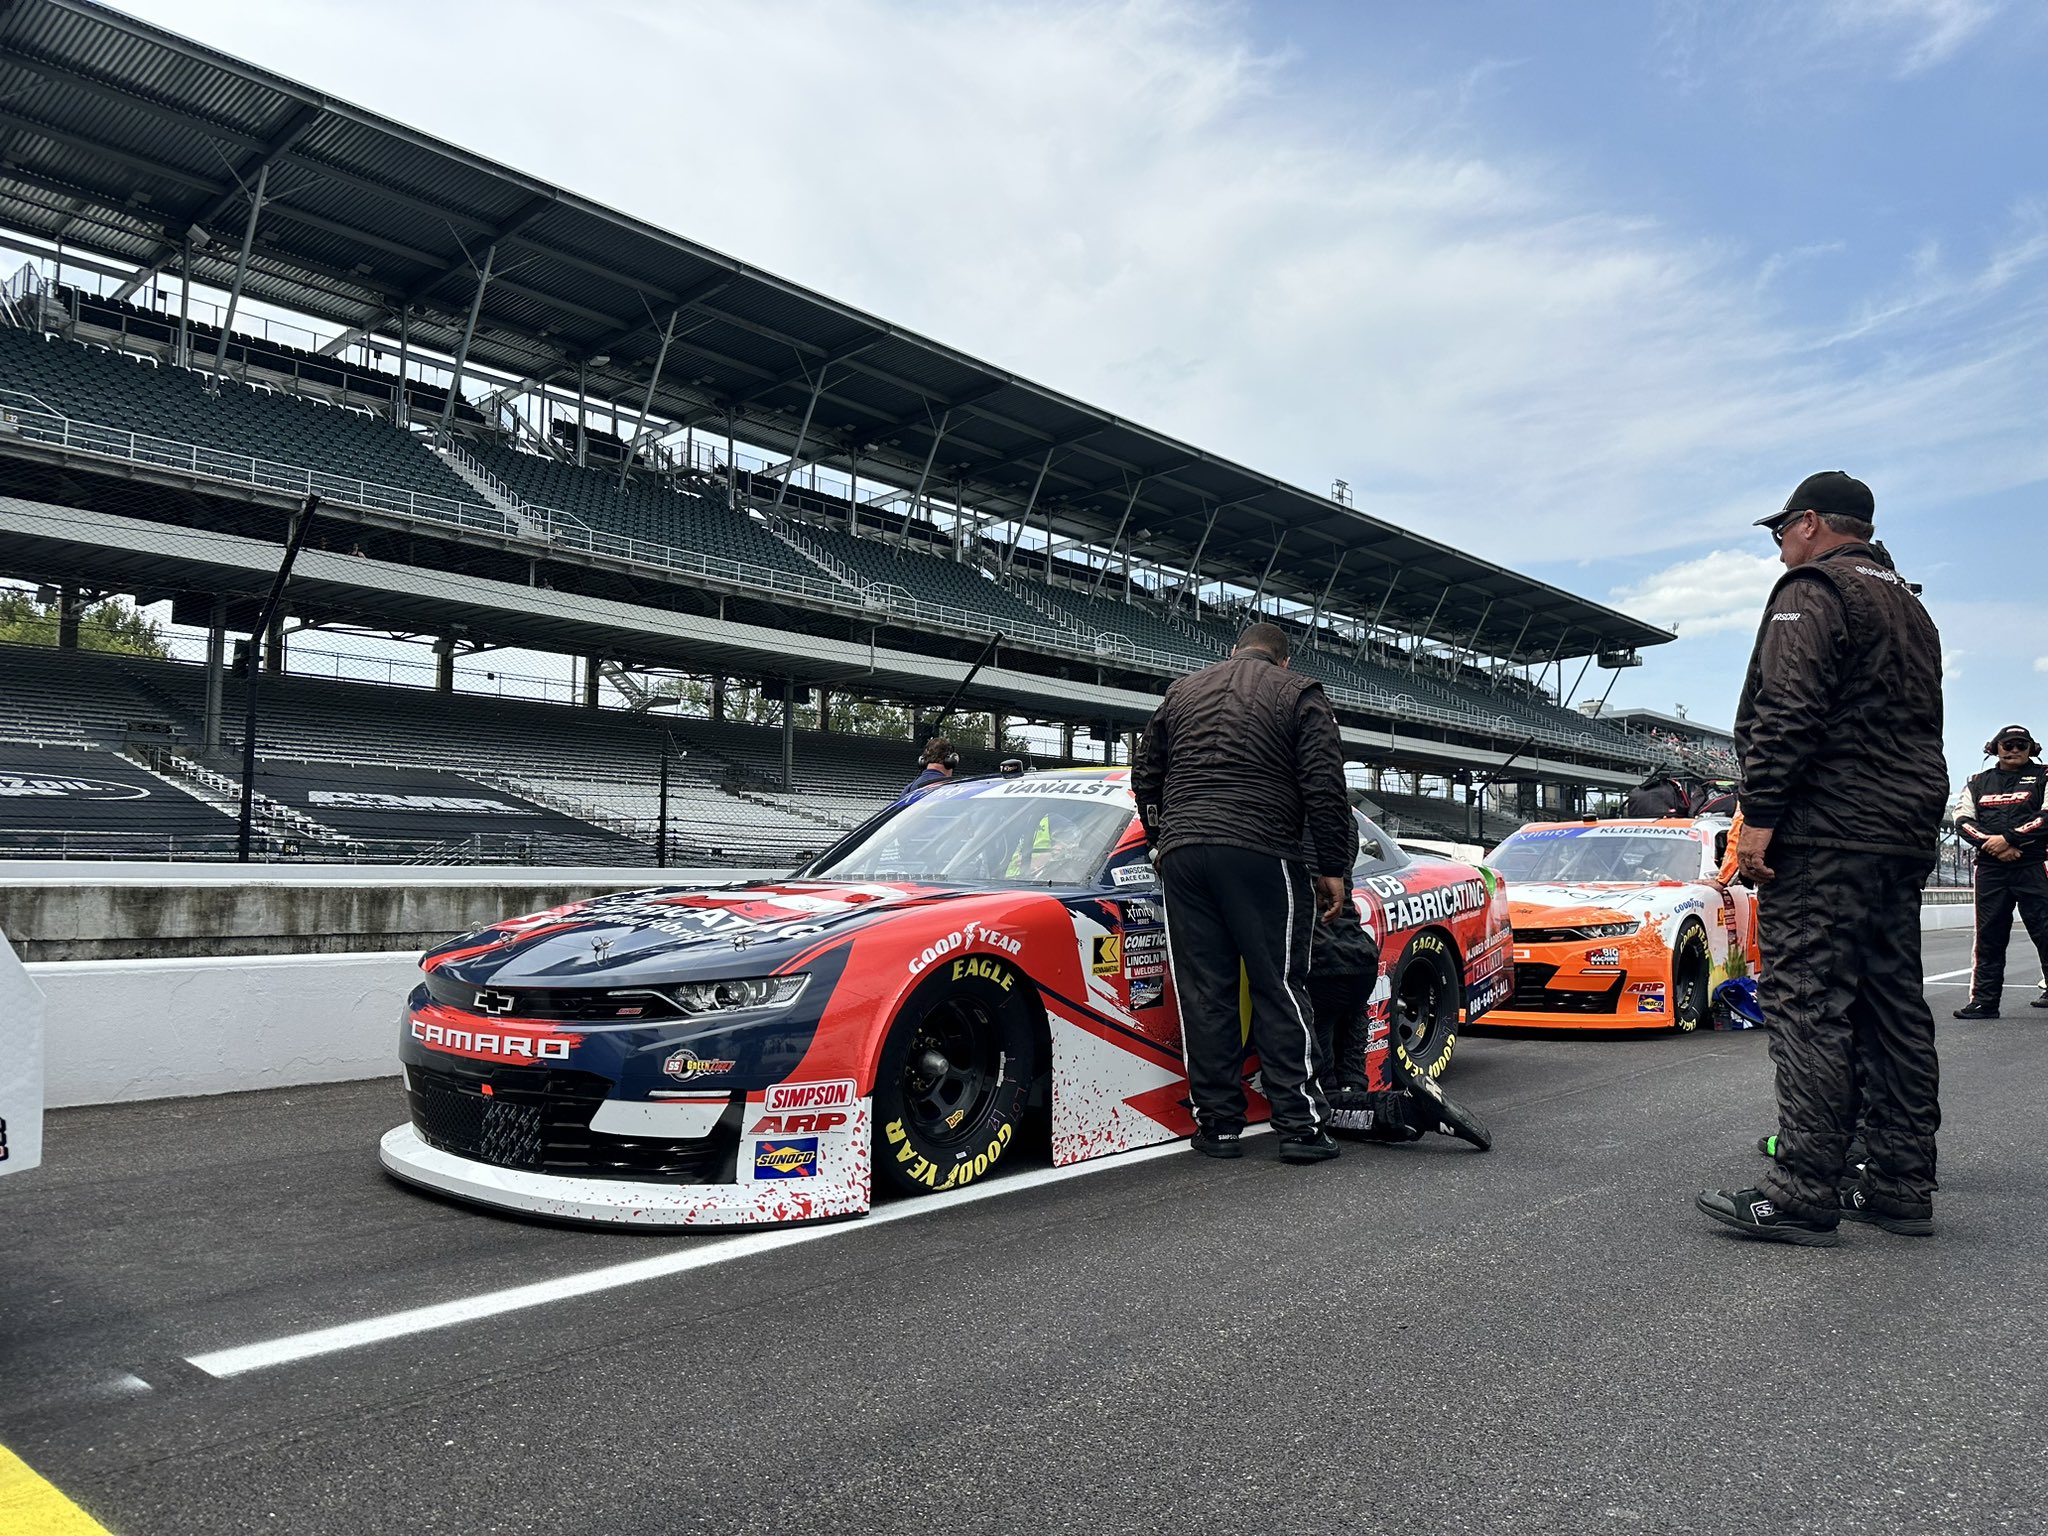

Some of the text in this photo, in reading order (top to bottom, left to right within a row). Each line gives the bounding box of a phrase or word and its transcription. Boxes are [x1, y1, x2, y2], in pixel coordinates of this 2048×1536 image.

[1004, 782, 1123, 797] VANALST
[1600, 827, 1690, 837] KLIGERMAN
[1120, 875, 1137, 883] RACE
[1366, 874, 1406, 899] CB
[1126, 904, 1155, 922] xfinity
[1383, 880, 1486, 933] FABRICATING
[1124, 933, 1167, 950] COMETIC
[1412, 936, 1445, 955] EAGLE
[908, 926, 1023, 975] GOOD YEAR
[1602, 948, 1619, 957] BIG
[1126, 953, 1161, 967] LINCOLN
[952, 957, 1015, 992] EAGLE
[1133, 965, 1164, 976] WELDERS
[1627, 983, 1665, 992] ARP
[1639, 1000, 1664, 1008] SUNOCO
[411, 1019, 571, 1060] CAMARO
[771, 1084, 849, 1110] SIMPSON
[749, 1112, 848, 1133] ARP
[758, 1152, 813, 1165] SUNOCO
[884, 1116, 1013, 1188] GOOD YEAR
